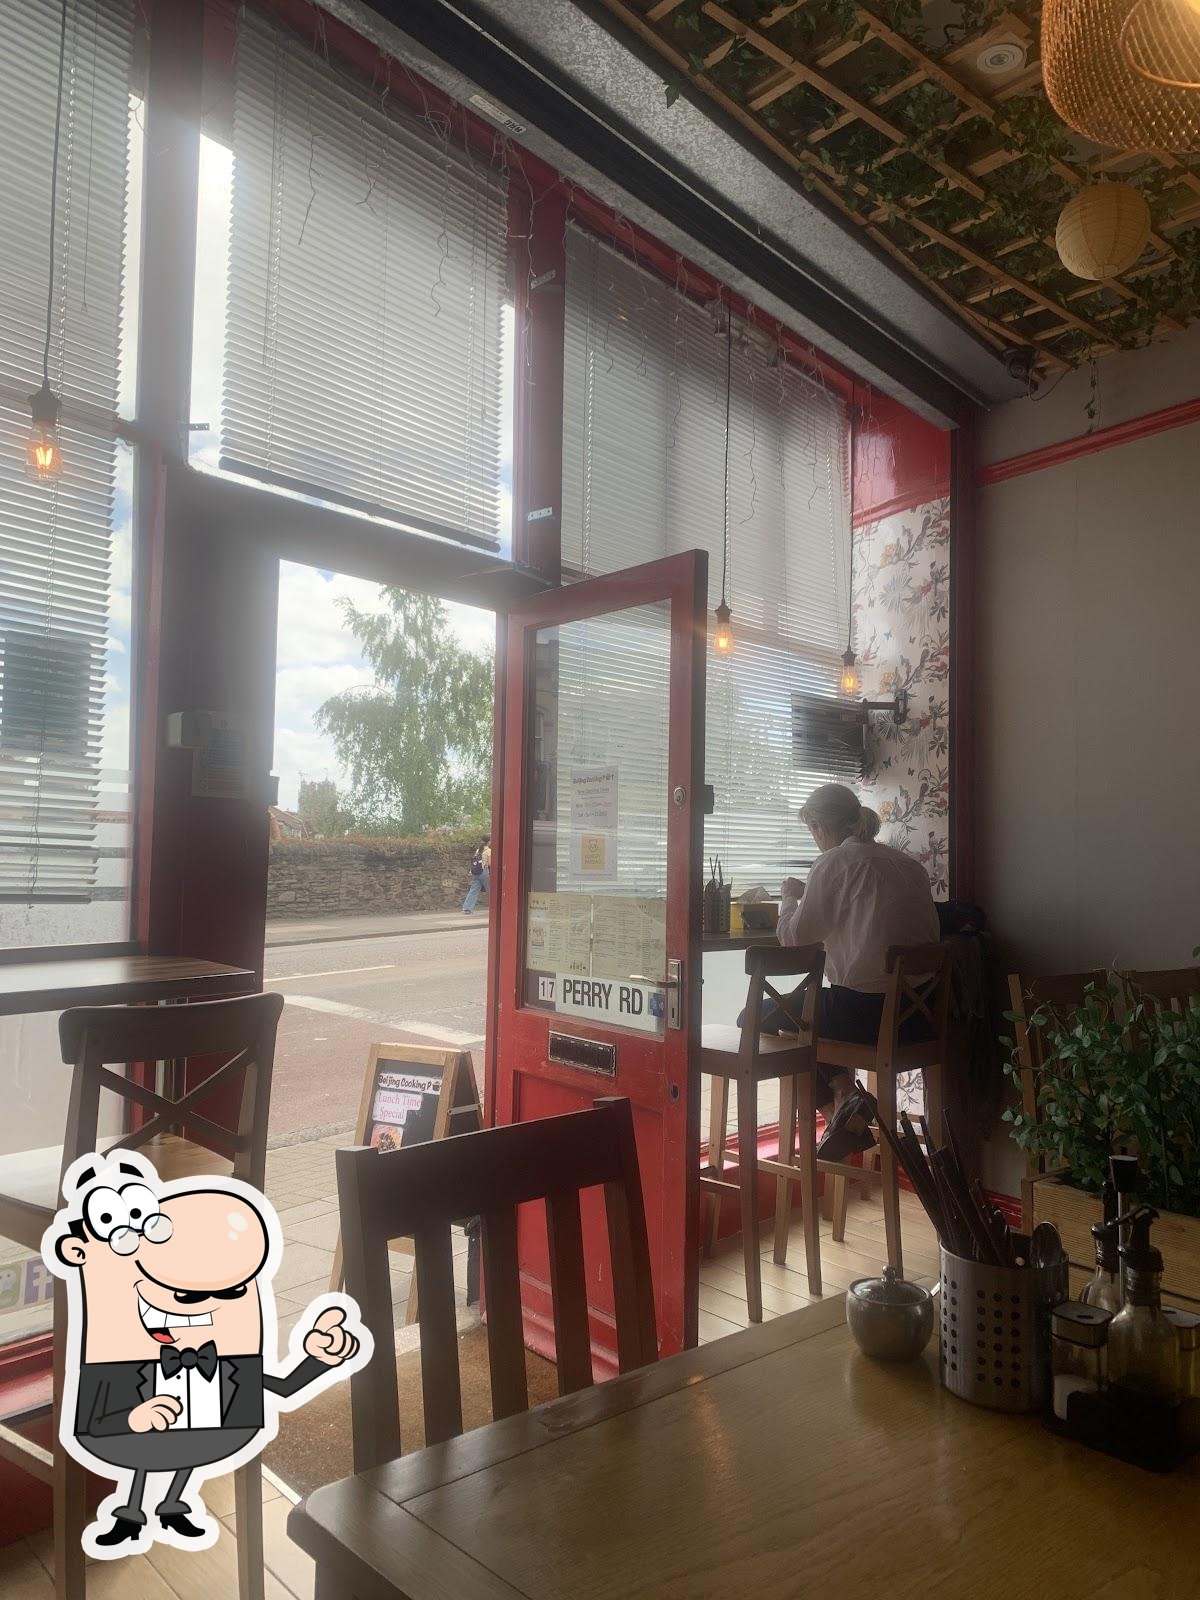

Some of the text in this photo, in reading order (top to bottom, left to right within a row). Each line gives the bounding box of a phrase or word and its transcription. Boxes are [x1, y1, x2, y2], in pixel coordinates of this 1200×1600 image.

[540, 979, 643, 1015] 17 PERRY RD
[378, 1075, 400, 1088] Beijing
[400, 1078, 426, 1091] Cooking
[378, 1091, 400, 1104] Lunch
[379, 1106, 405, 1120] Special
